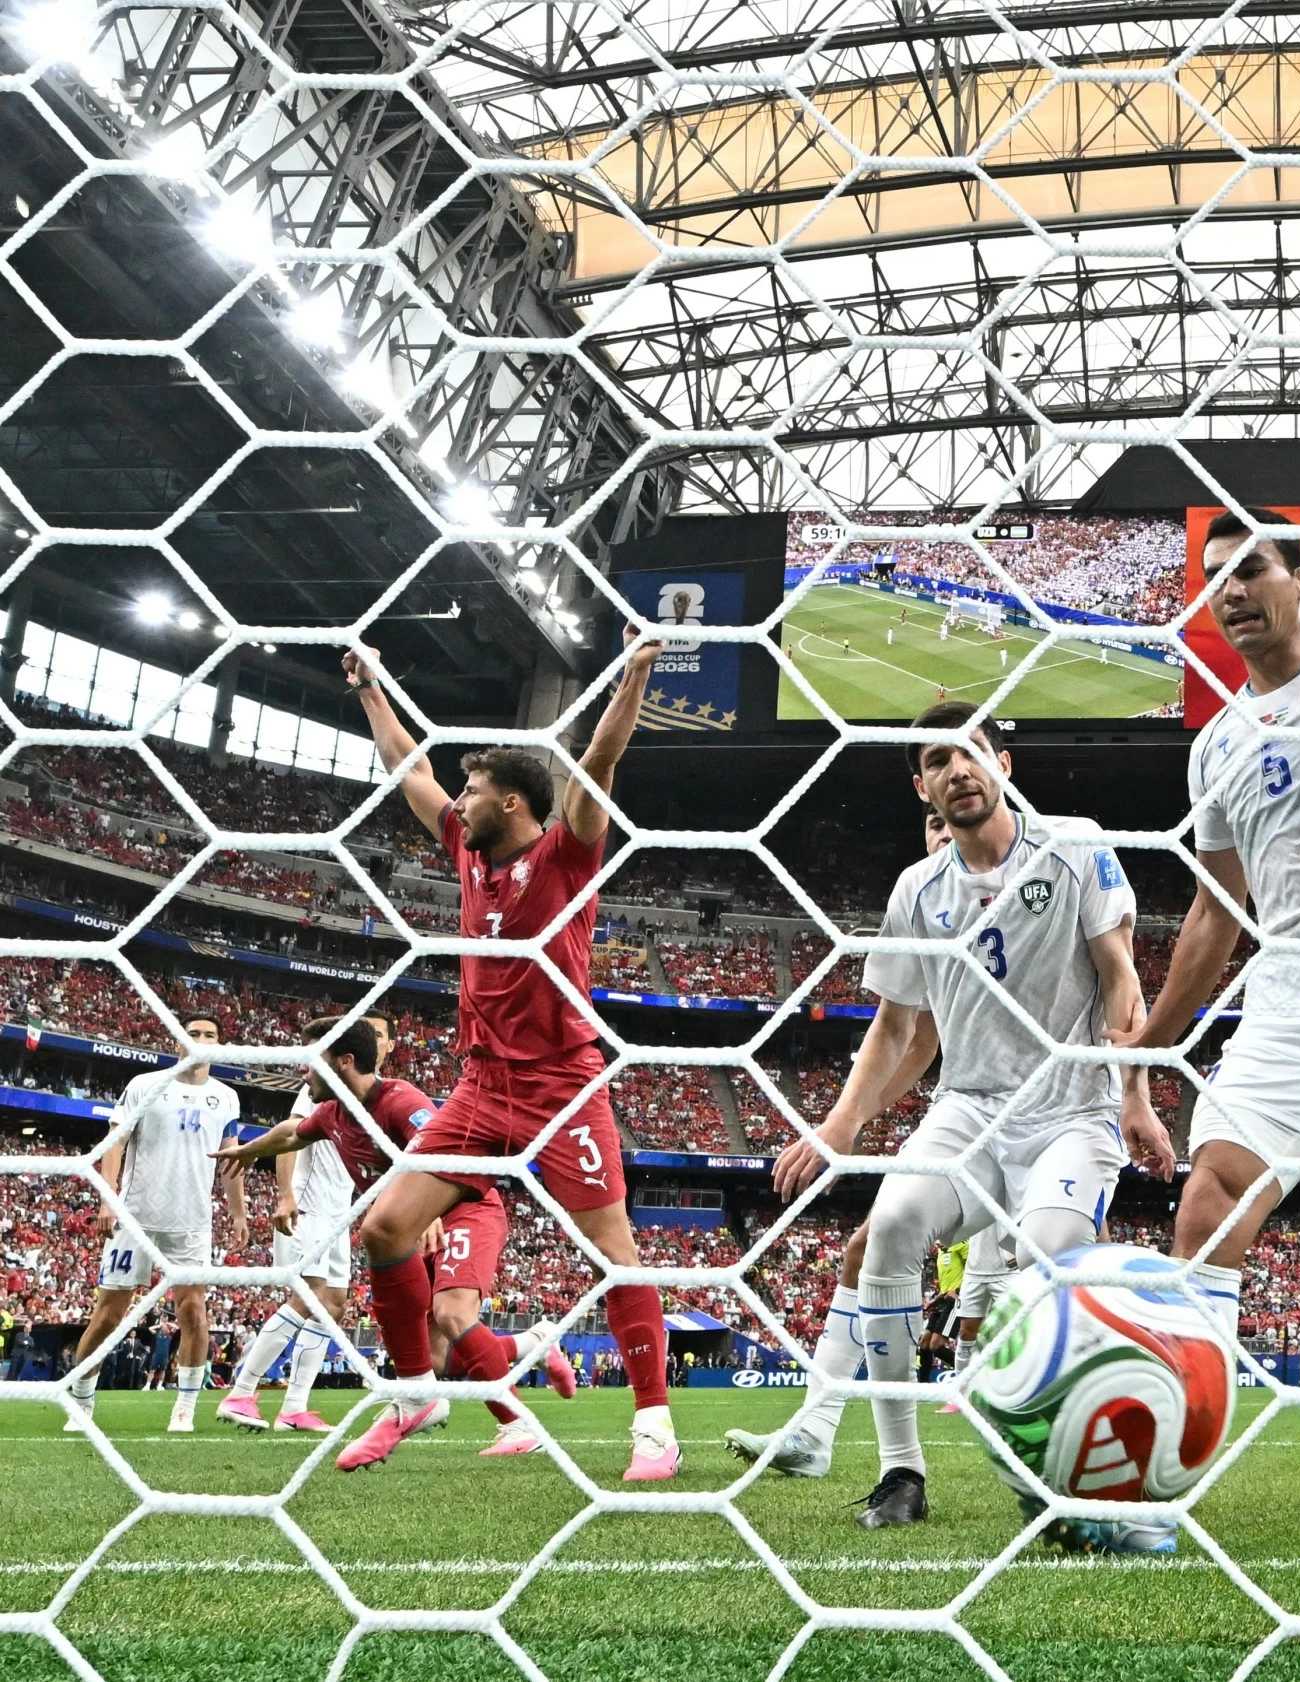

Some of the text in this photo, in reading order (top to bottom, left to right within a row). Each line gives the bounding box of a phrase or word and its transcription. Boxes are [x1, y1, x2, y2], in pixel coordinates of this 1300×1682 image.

[1101, 639, 1132, 652] HYUNDAI
[654, 662, 700, 672] 2026
[1260, 744, 1293, 799] 5
[1024, 884, 1049, 900] UFA
[74, 914, 128, 933] HOUSTO
[977, 928, 1007, 981] 3
[290, 962, 380, 983] FIFA WORLD CUP 202
[93, 1043, 158, 1064] HOUSTON
[178, 1108, 201, 1132] 14
[569, 1125, 603, 1173] 3
[708, 1157, 764, 1168] HOUSTON
[109, 1249, 132, 1274] 14
